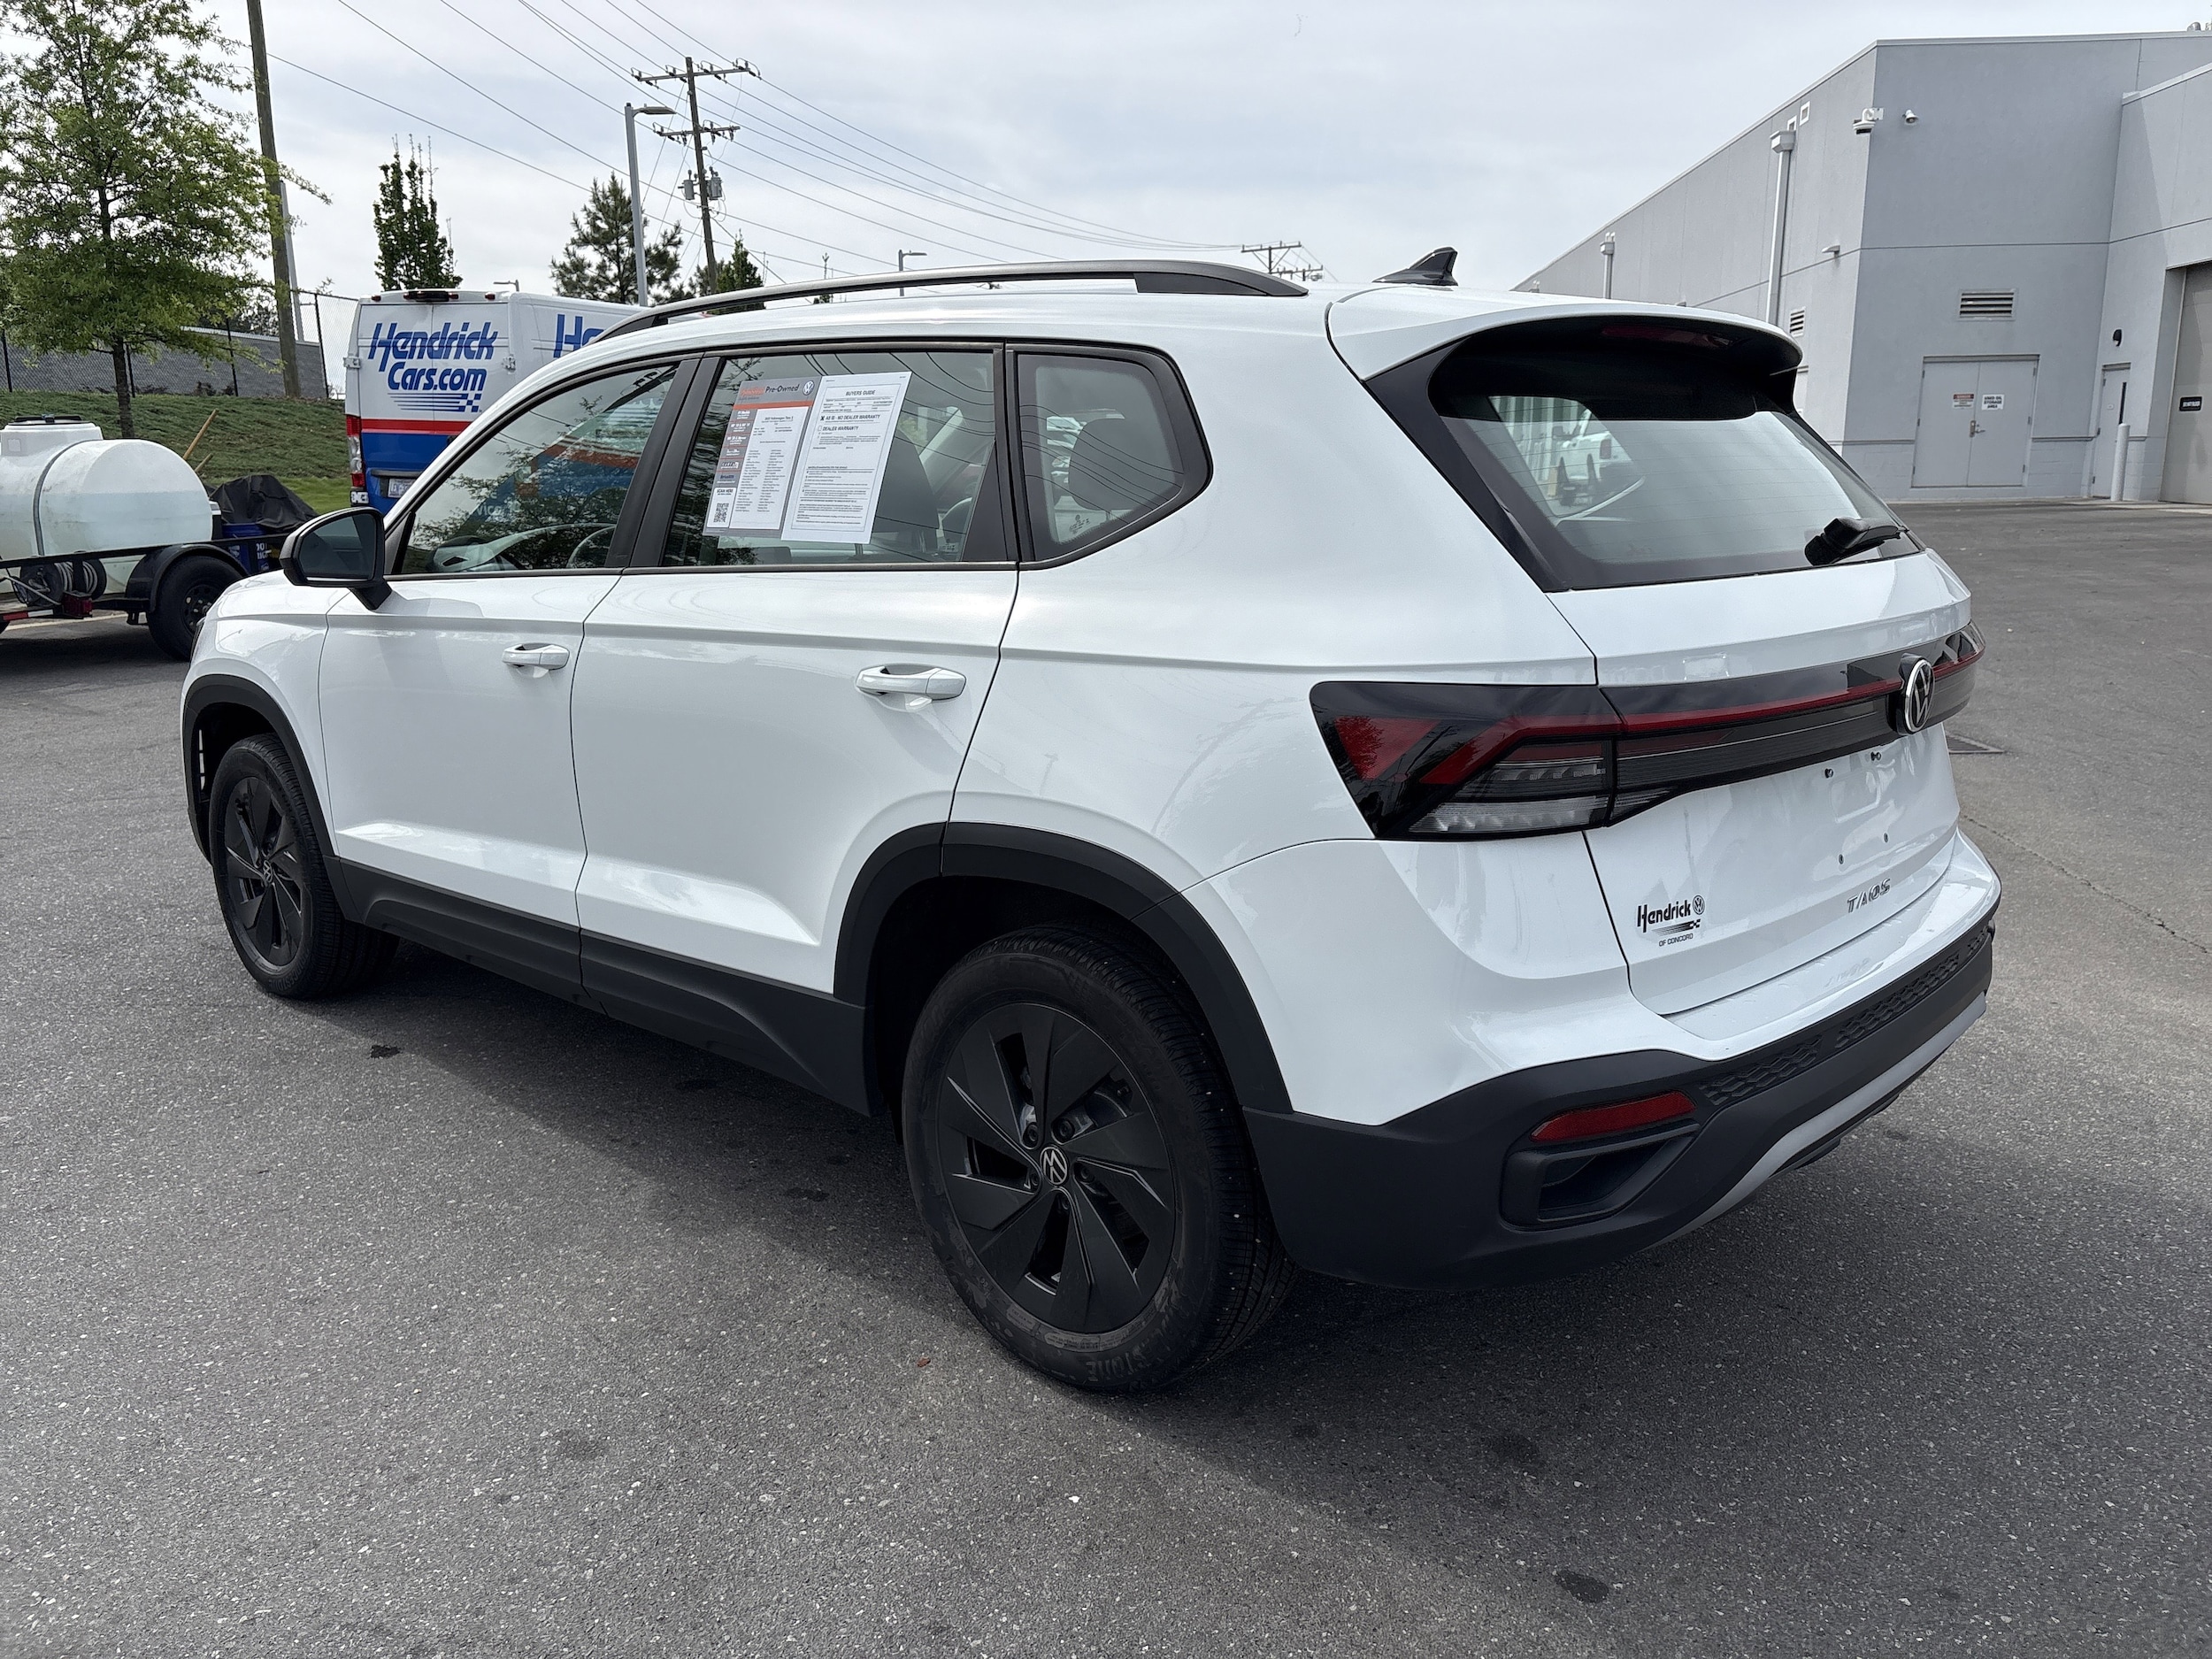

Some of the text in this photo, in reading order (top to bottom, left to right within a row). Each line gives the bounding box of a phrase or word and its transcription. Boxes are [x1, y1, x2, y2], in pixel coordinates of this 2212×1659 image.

[368, 322, 498, 373] Hendrick
[388, 362, 487, 391] Cars.com
[765, 384, 800, 394] Pre-Owned
[1847, 877, 1891, 913] TAOS
[1637, 899, 1691, 933] Hendrick
[1667, 933, 1694, 945] CONCORD
